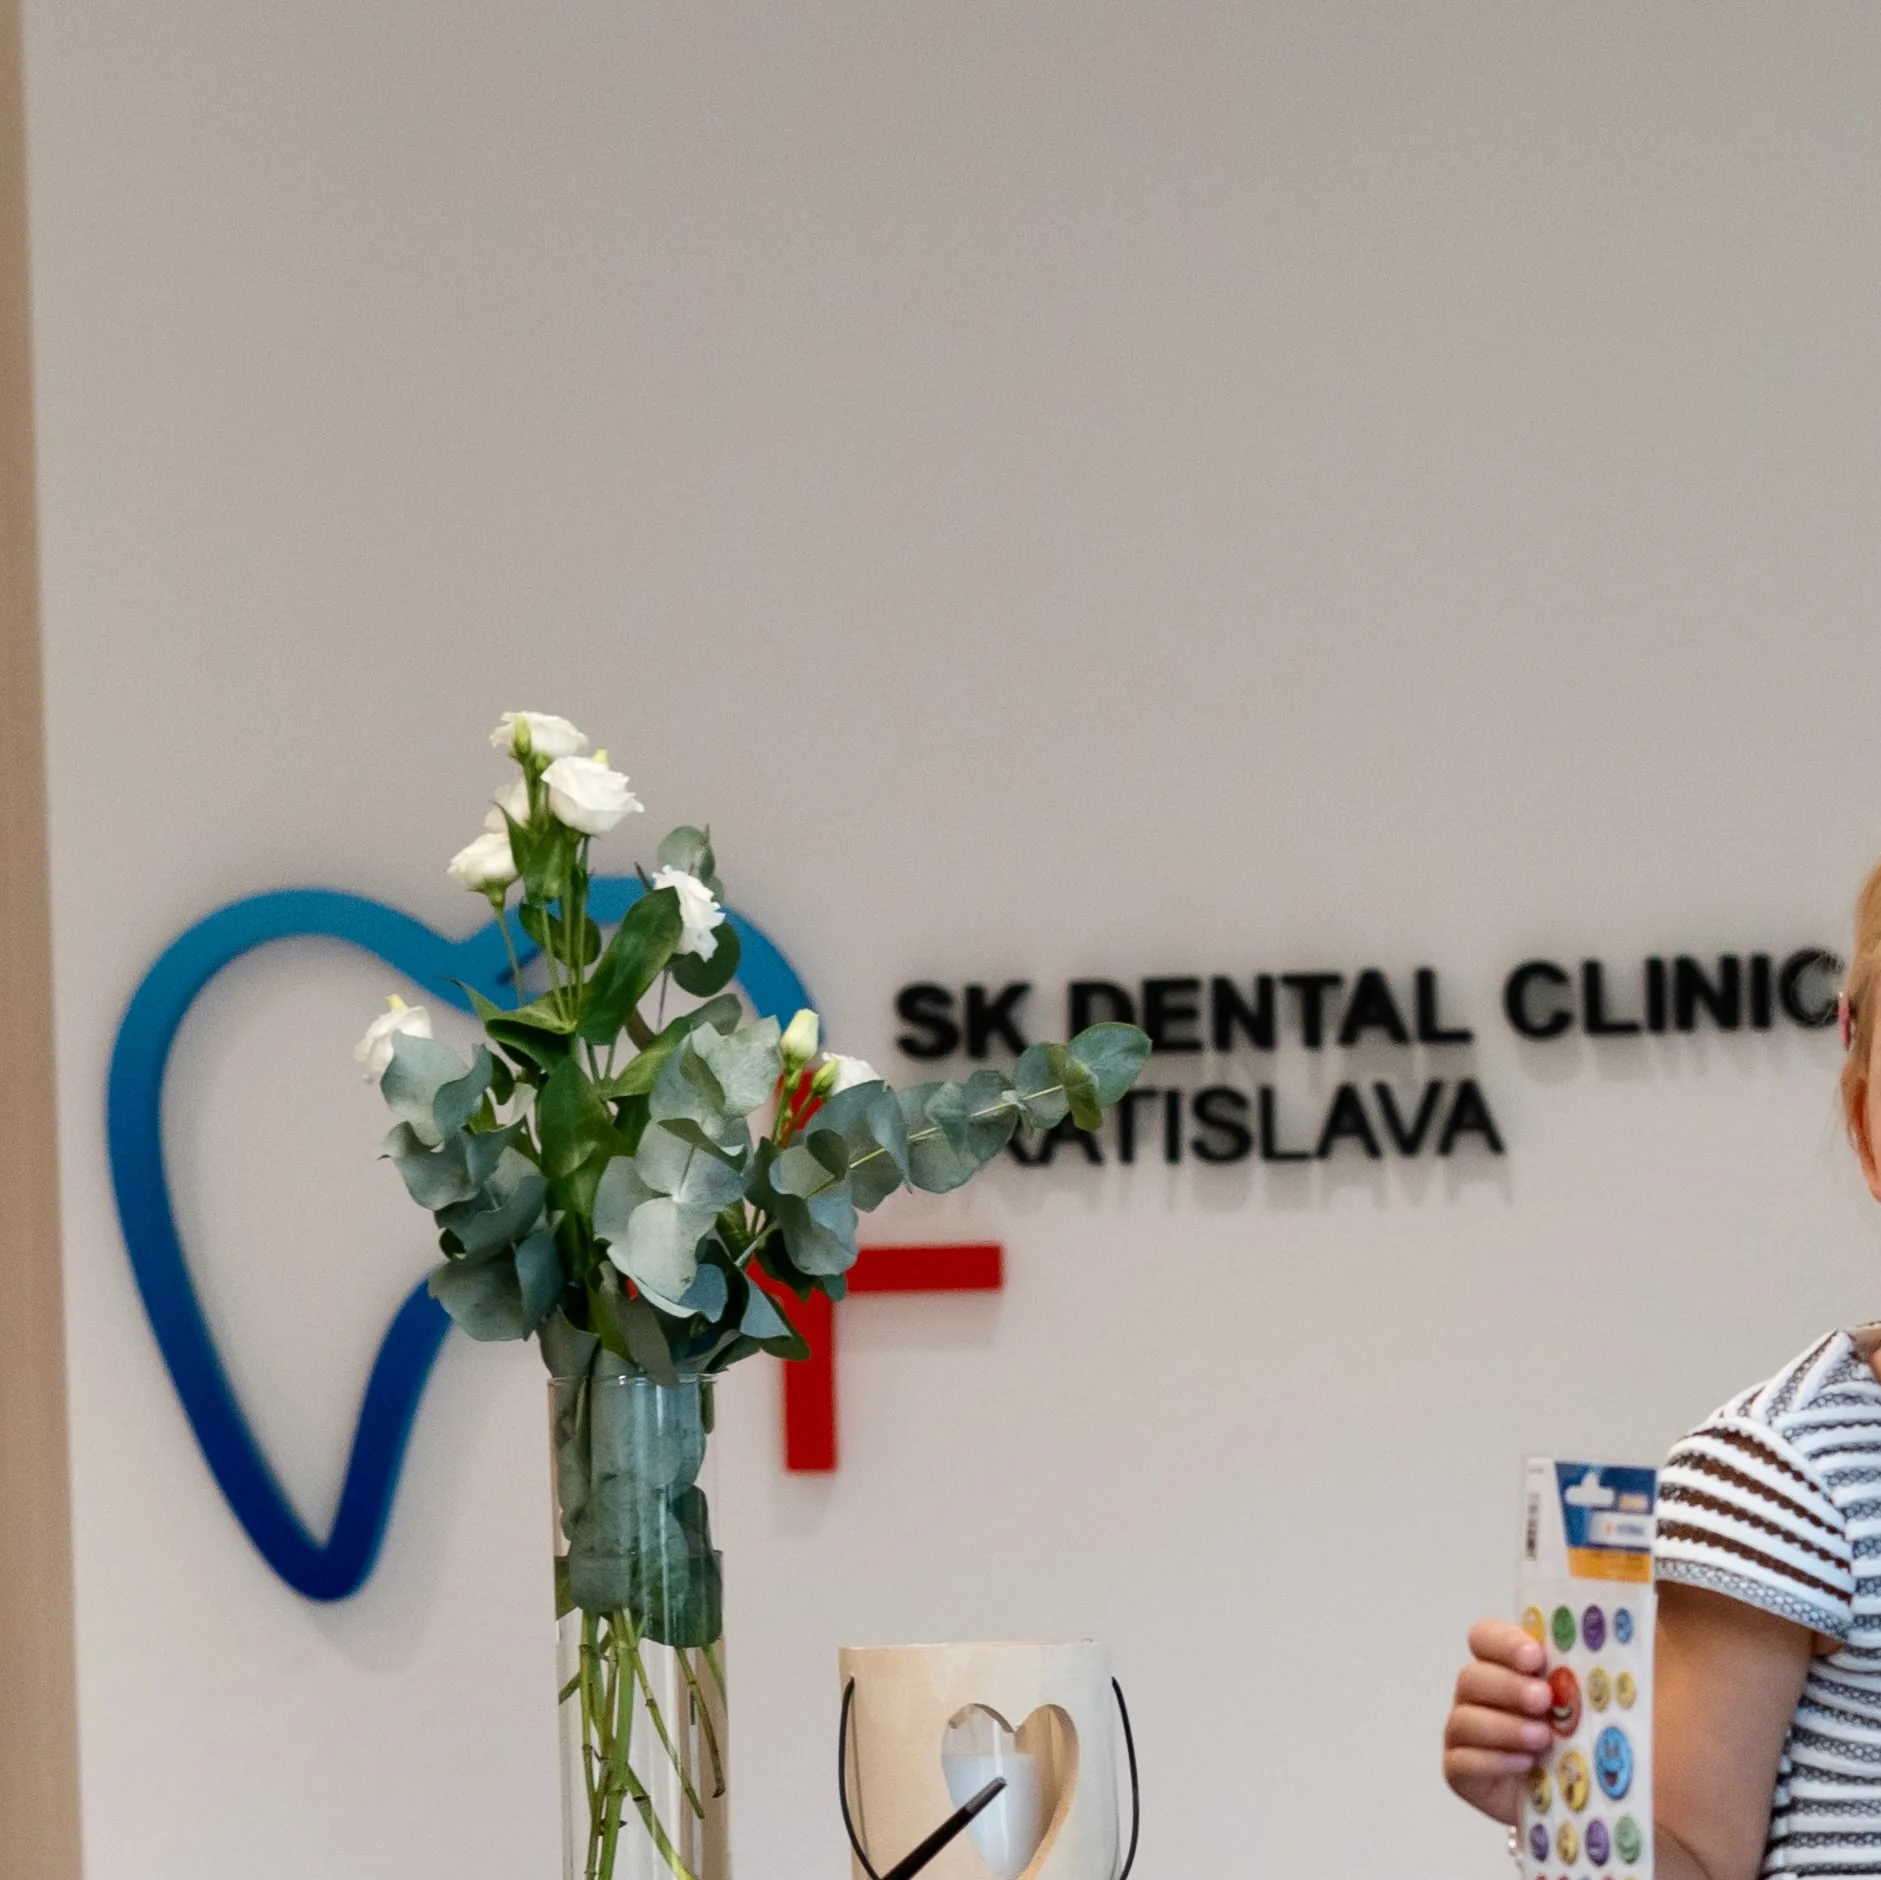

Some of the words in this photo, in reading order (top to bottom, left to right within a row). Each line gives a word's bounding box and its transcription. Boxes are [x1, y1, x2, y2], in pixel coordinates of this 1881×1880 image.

[895, 982, 1031, 1060] SK
[1068, 969, 1473, 1053] DENTAL
[1505, 946, 1843, 1038] CLINIC
